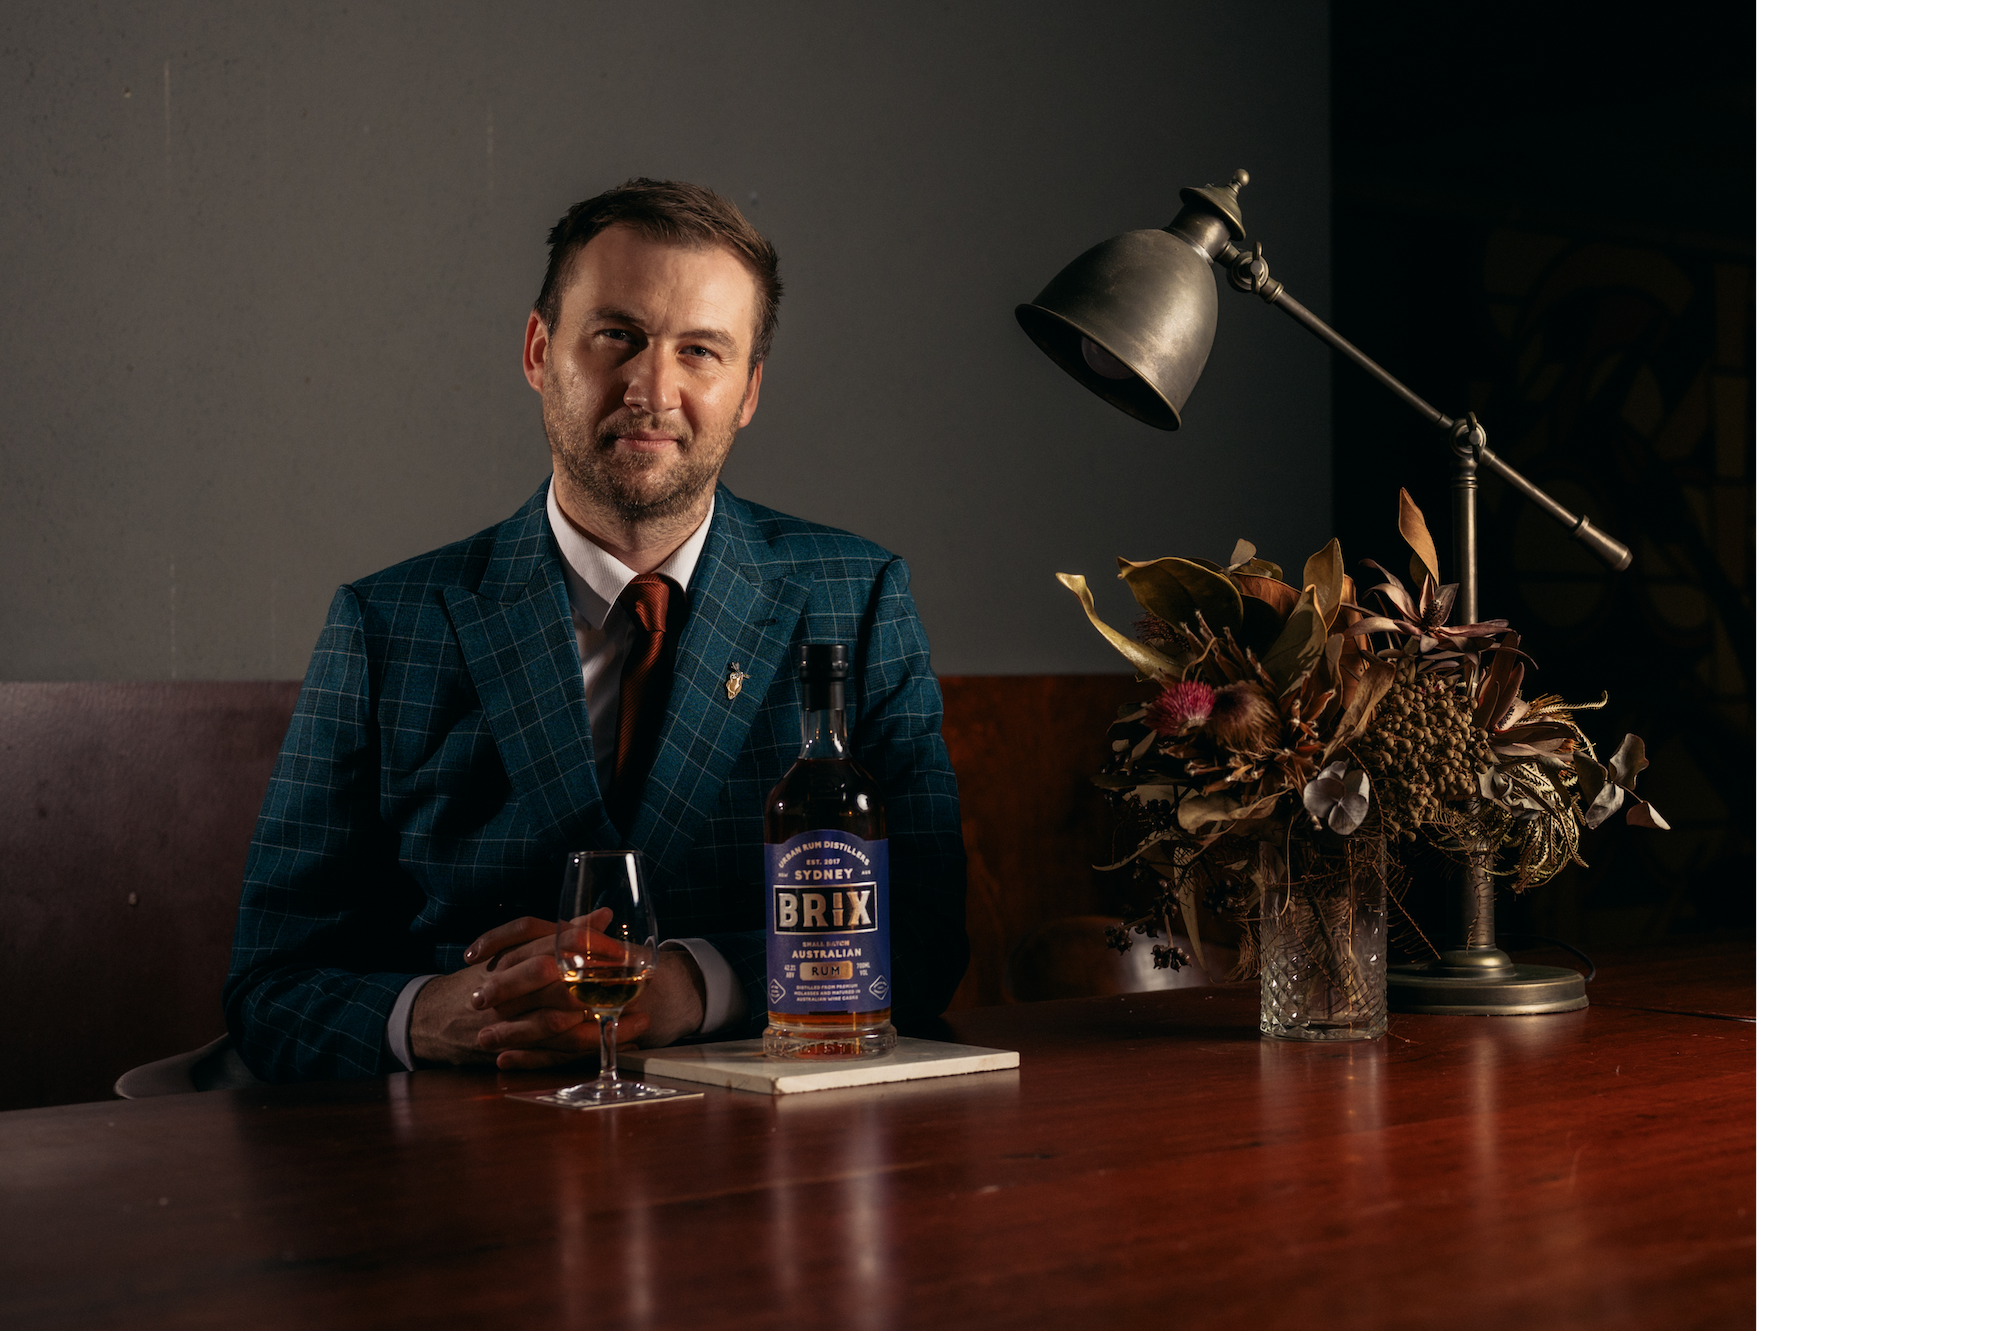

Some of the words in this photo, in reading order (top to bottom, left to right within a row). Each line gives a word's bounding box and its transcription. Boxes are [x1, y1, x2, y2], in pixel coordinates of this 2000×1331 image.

[778, 847, 802, 868] URBAN
[802, 841, 822, 851] RUM
[823, 840, 870, 866] DISTILLERS
[794, 868, 853, 880] SYDNEY
[778, 890, 872, 927] BRIX
[791, 948, 862, 959] AUSTRALIAN
[811, 966, 840, 976] RUM
